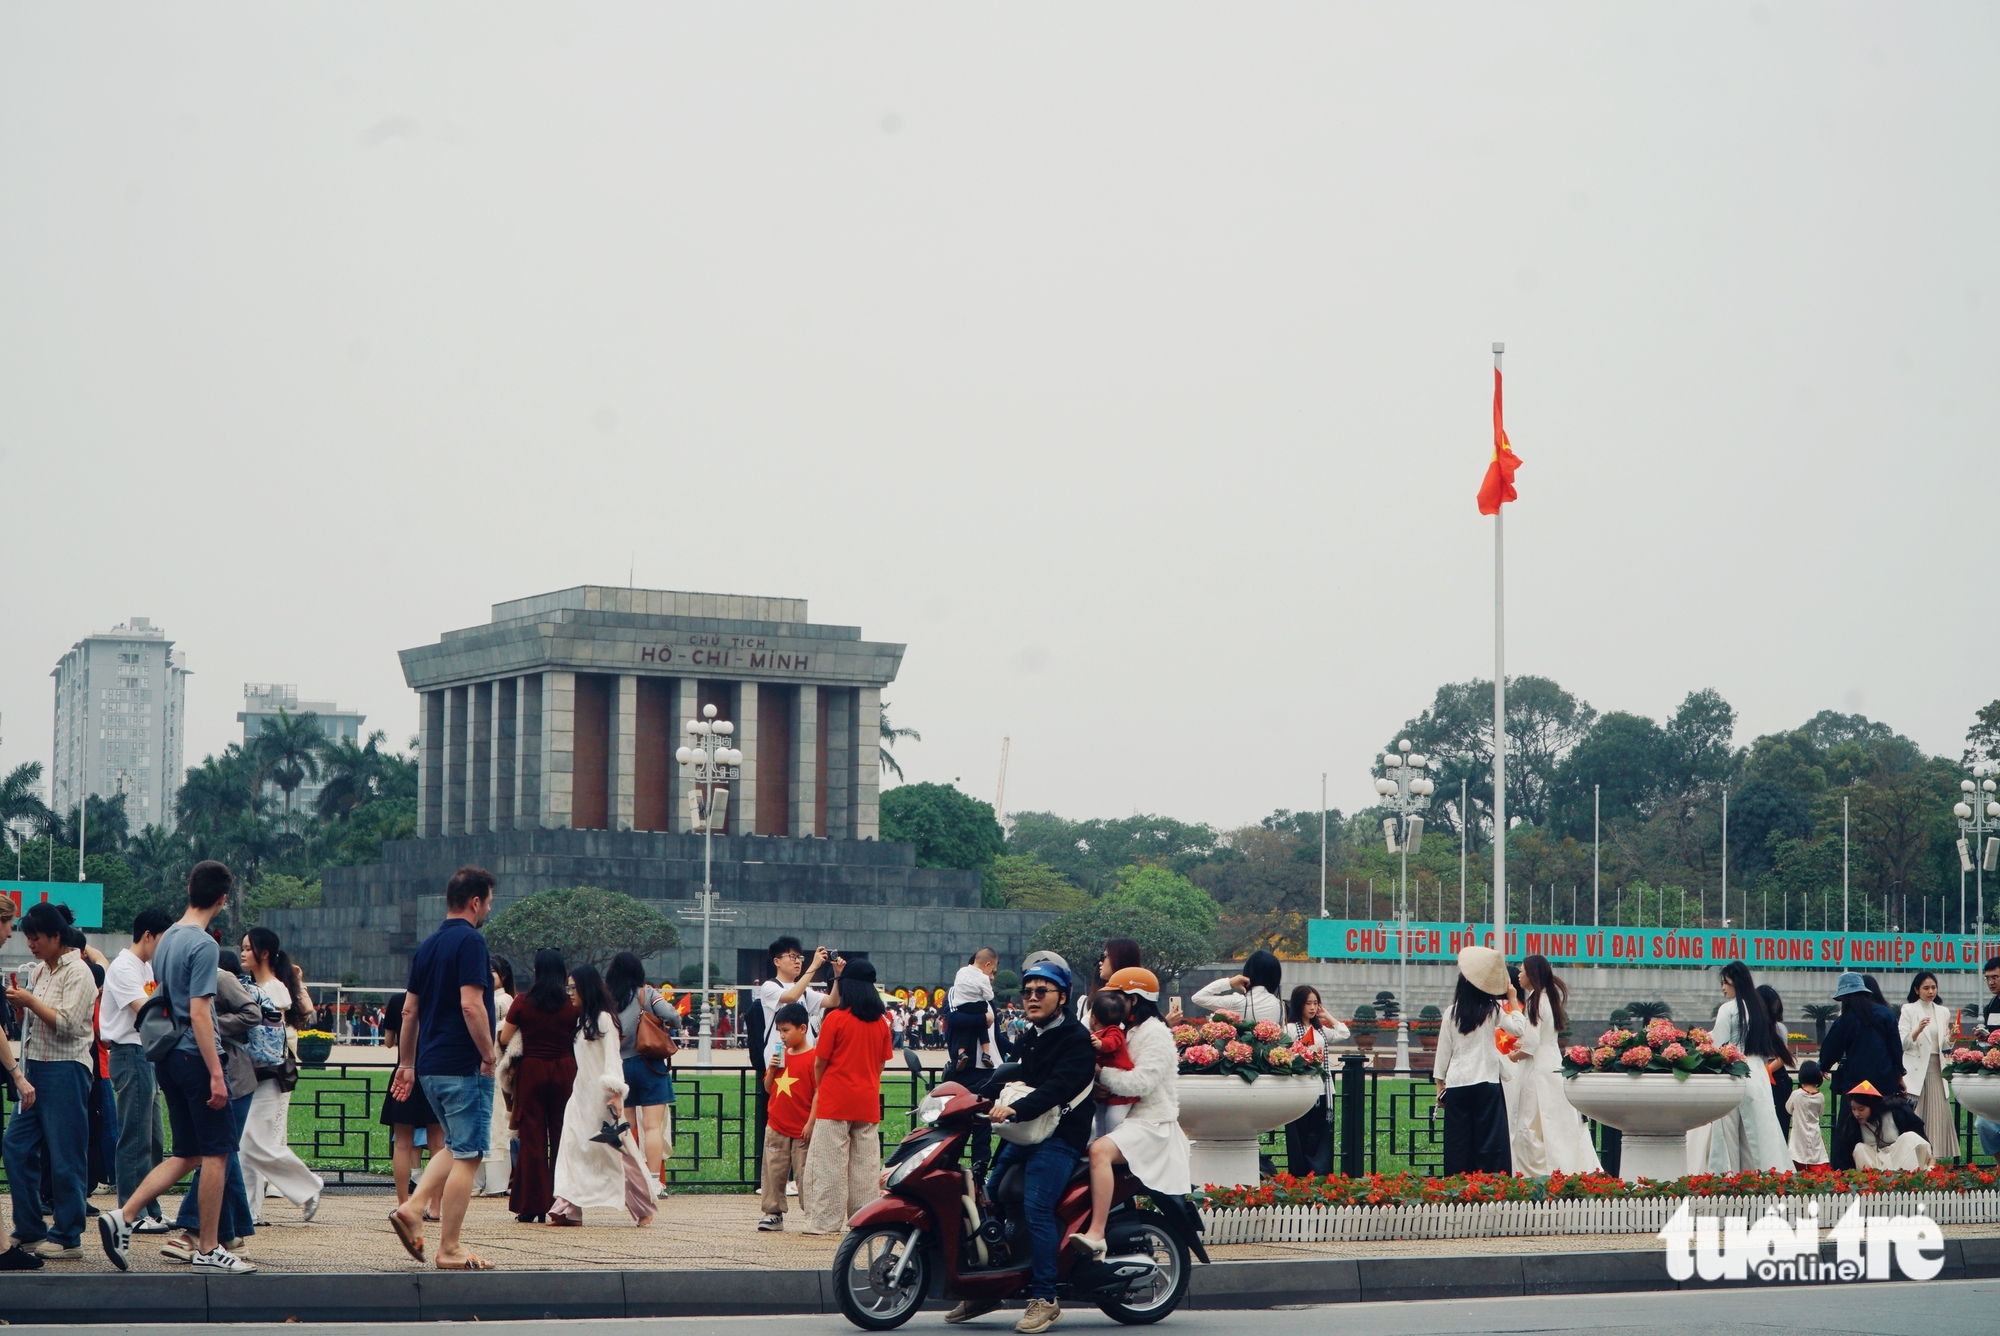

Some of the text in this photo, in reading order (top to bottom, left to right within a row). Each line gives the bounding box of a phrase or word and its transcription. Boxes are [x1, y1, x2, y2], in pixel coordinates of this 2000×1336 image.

[1346, 921, 1387, 953] CHỦ
[1525, 932, 1577, 957] MINH
[1586, 930, 1605, 958] VĨ
[1612, 934, 1644, 963] ĐẠI
[1652, 928, 1704, 959] SỐNG
[1711, 933, 1746, 960] MÃI
[1753, 937, 1814, 961] TRONG
[1821, 936, 1846, 966] SỰ
[1851, 935, 1916, 967] NGHIỆP
[1921, 934, 1956, 964] CỦA
